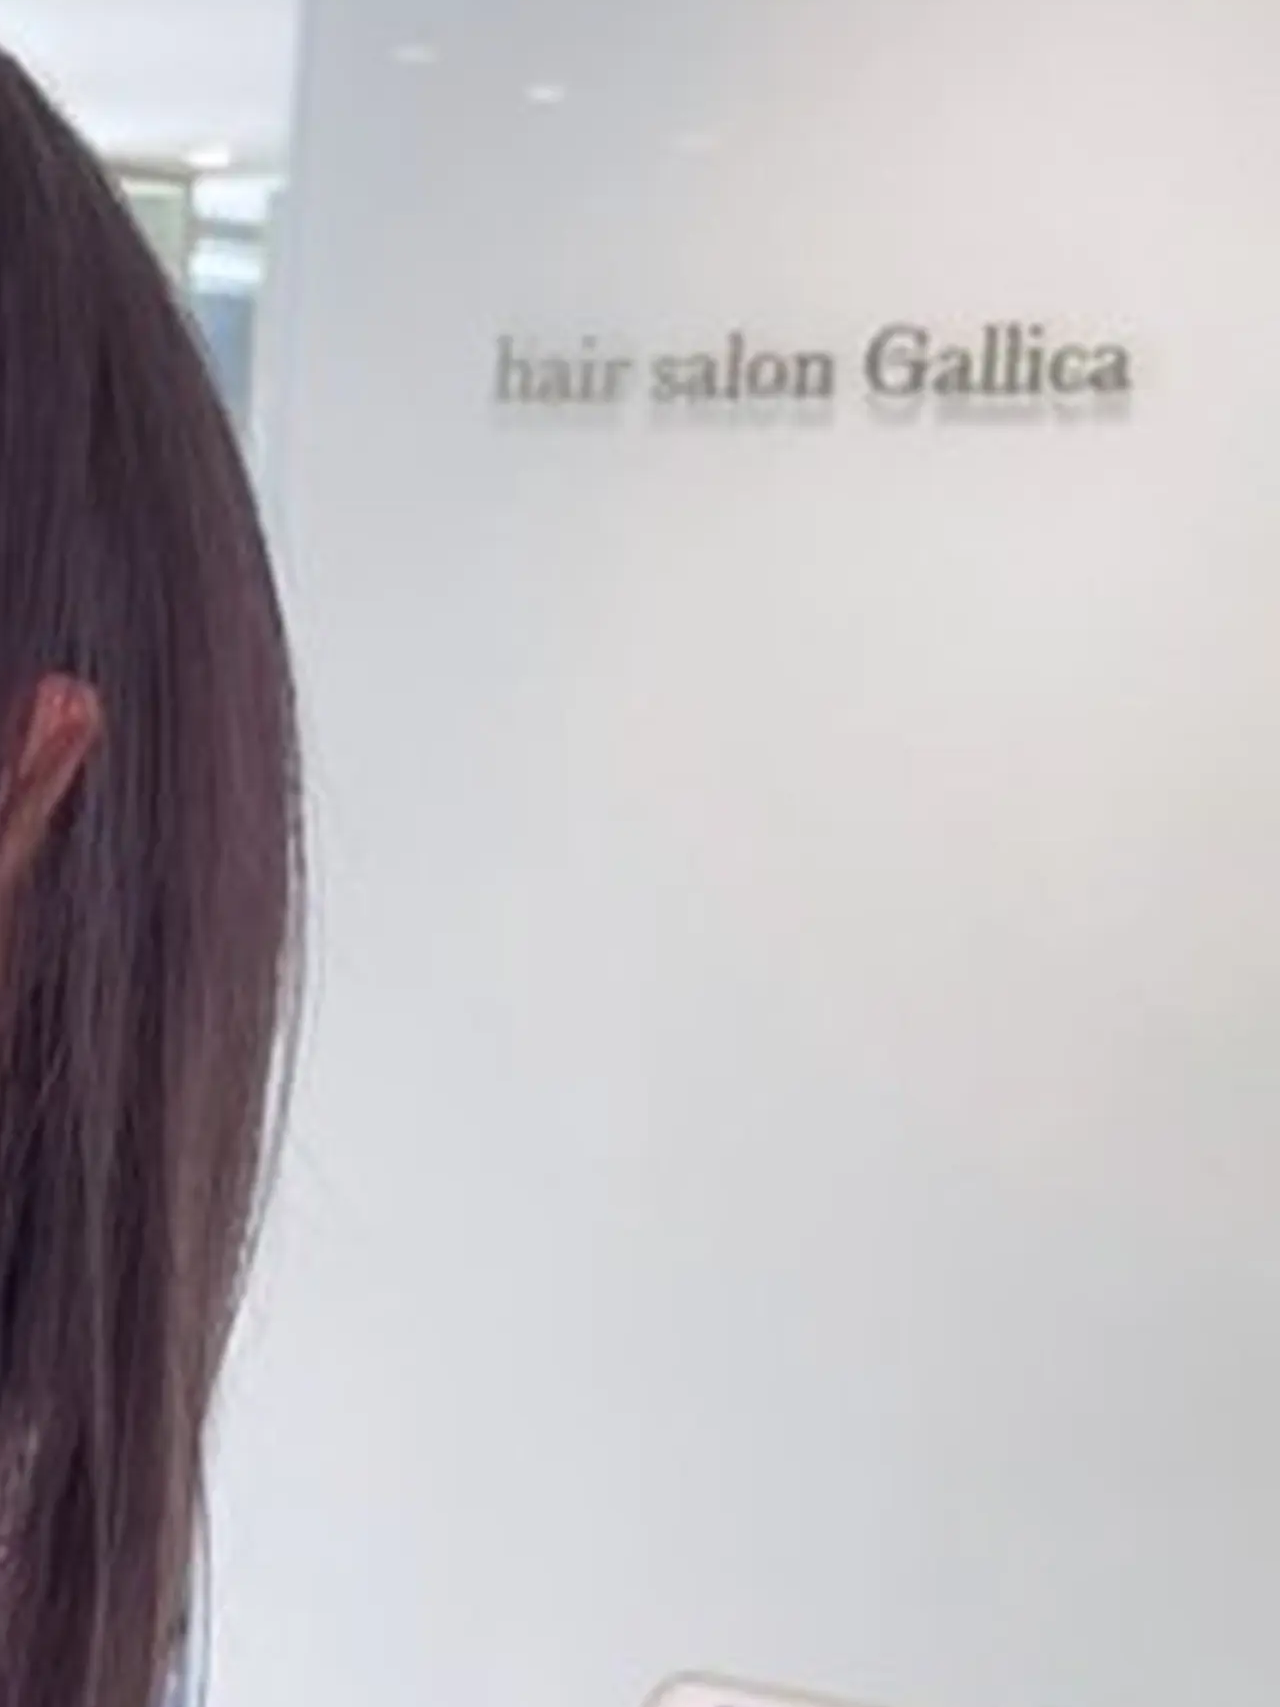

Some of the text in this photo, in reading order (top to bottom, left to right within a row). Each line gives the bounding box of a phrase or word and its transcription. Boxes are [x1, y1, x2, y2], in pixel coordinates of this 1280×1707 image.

[493, 322, 1134, 405] hair salon Gallica
